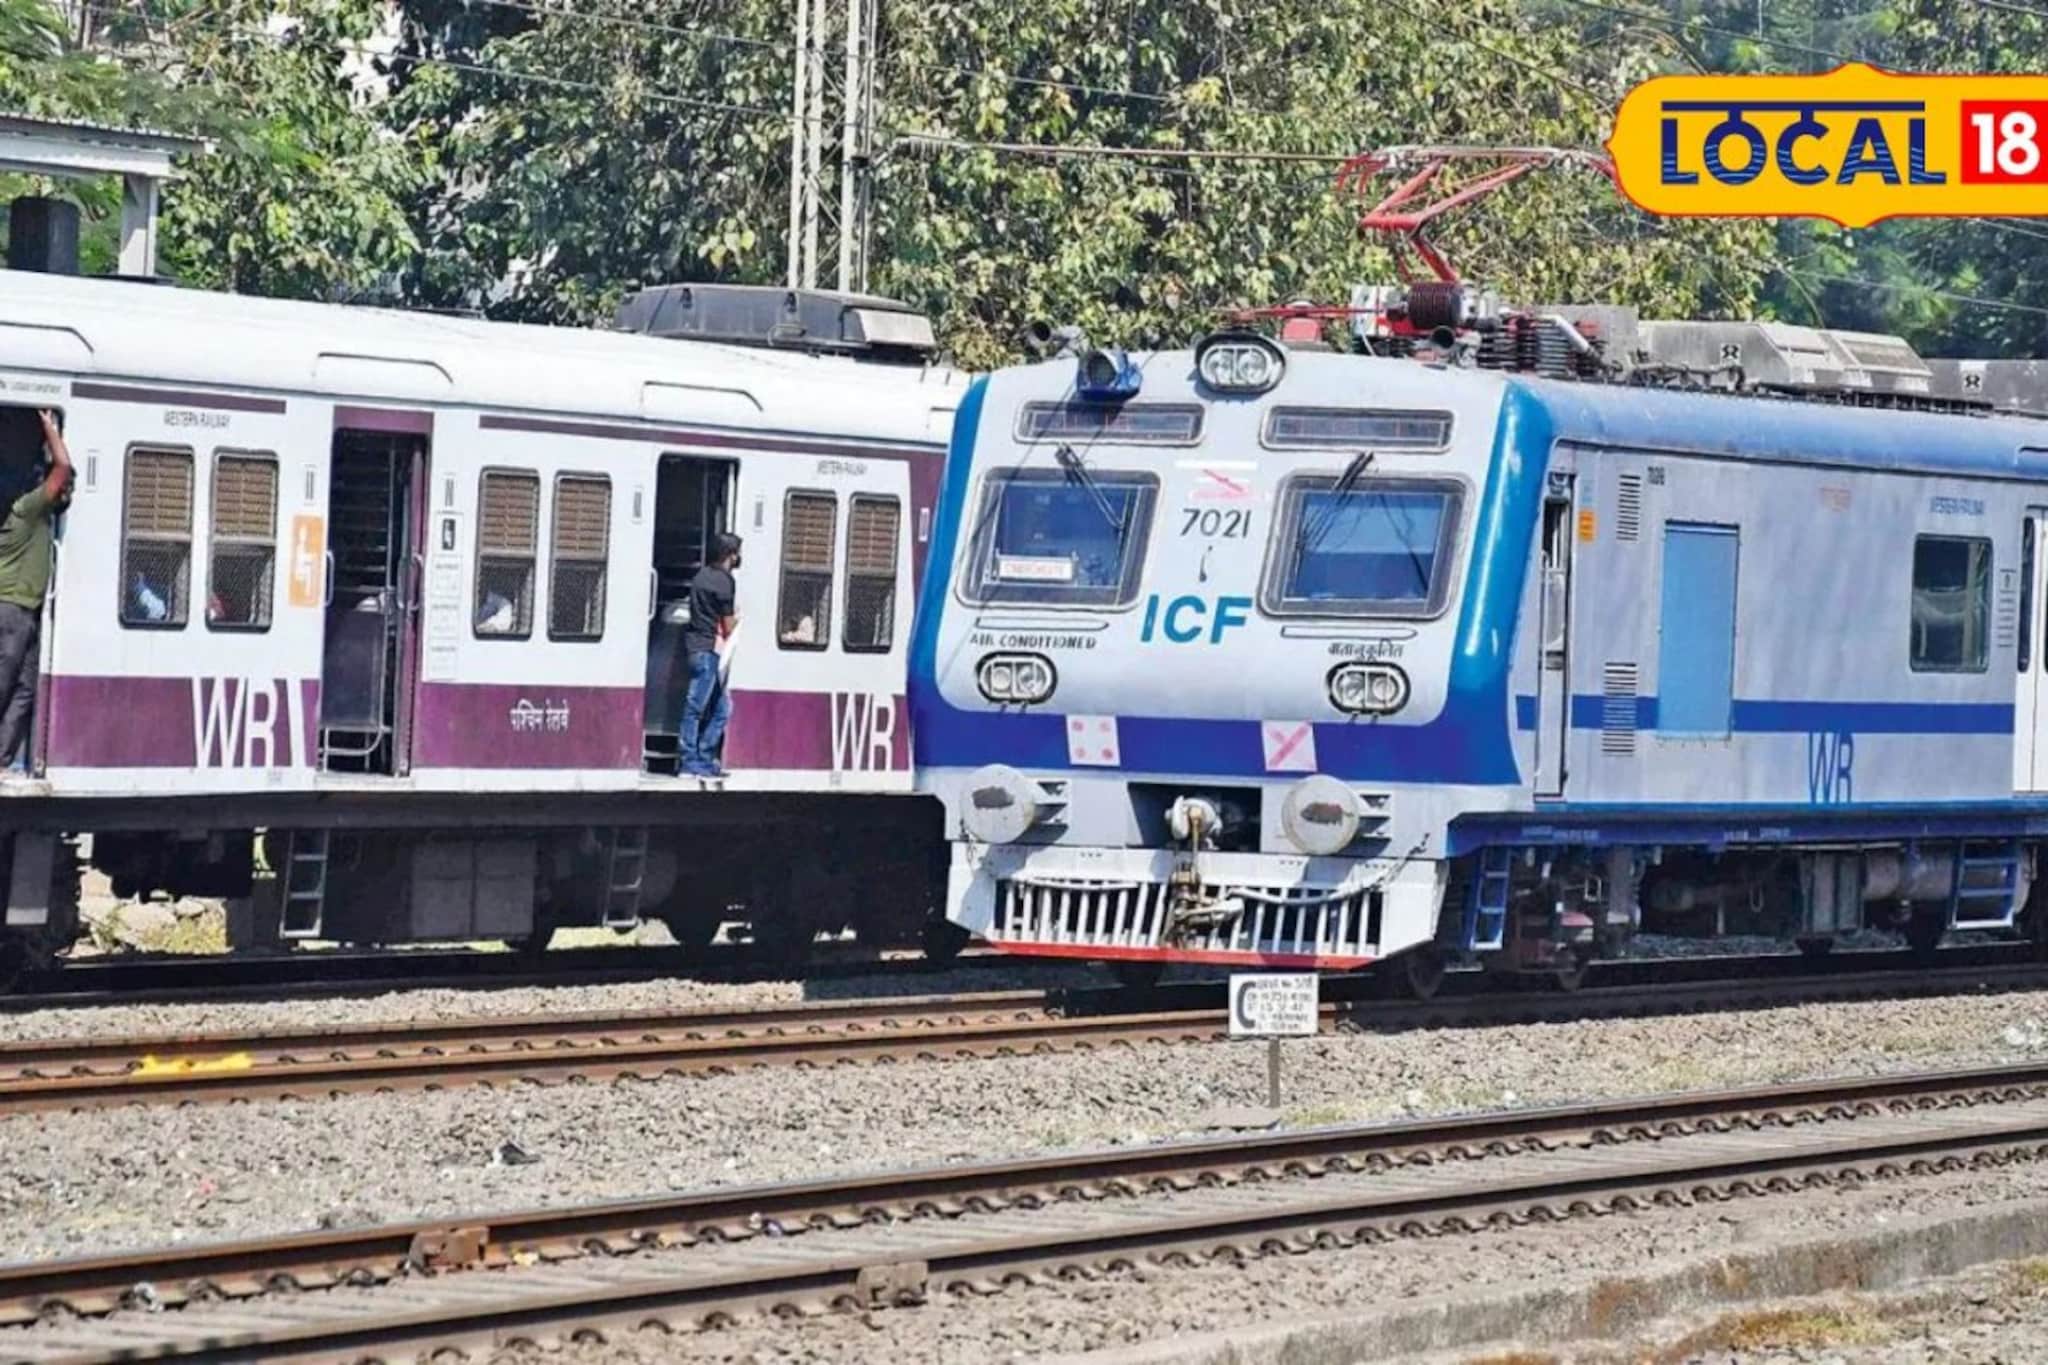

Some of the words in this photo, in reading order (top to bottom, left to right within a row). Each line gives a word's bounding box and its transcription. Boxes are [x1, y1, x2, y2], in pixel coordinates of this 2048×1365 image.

[1181, 508, 1251, 538] 7021
[970, 633, 995, 646] AIR
[1000, 634, 1096, 649] CONDITIONED
[1141, 594, 1253, 644] ICF
[193, 677, 278, 768] WR
[831, 692, 896, 770] WR
[1809, 732, 1854, 803] WR
